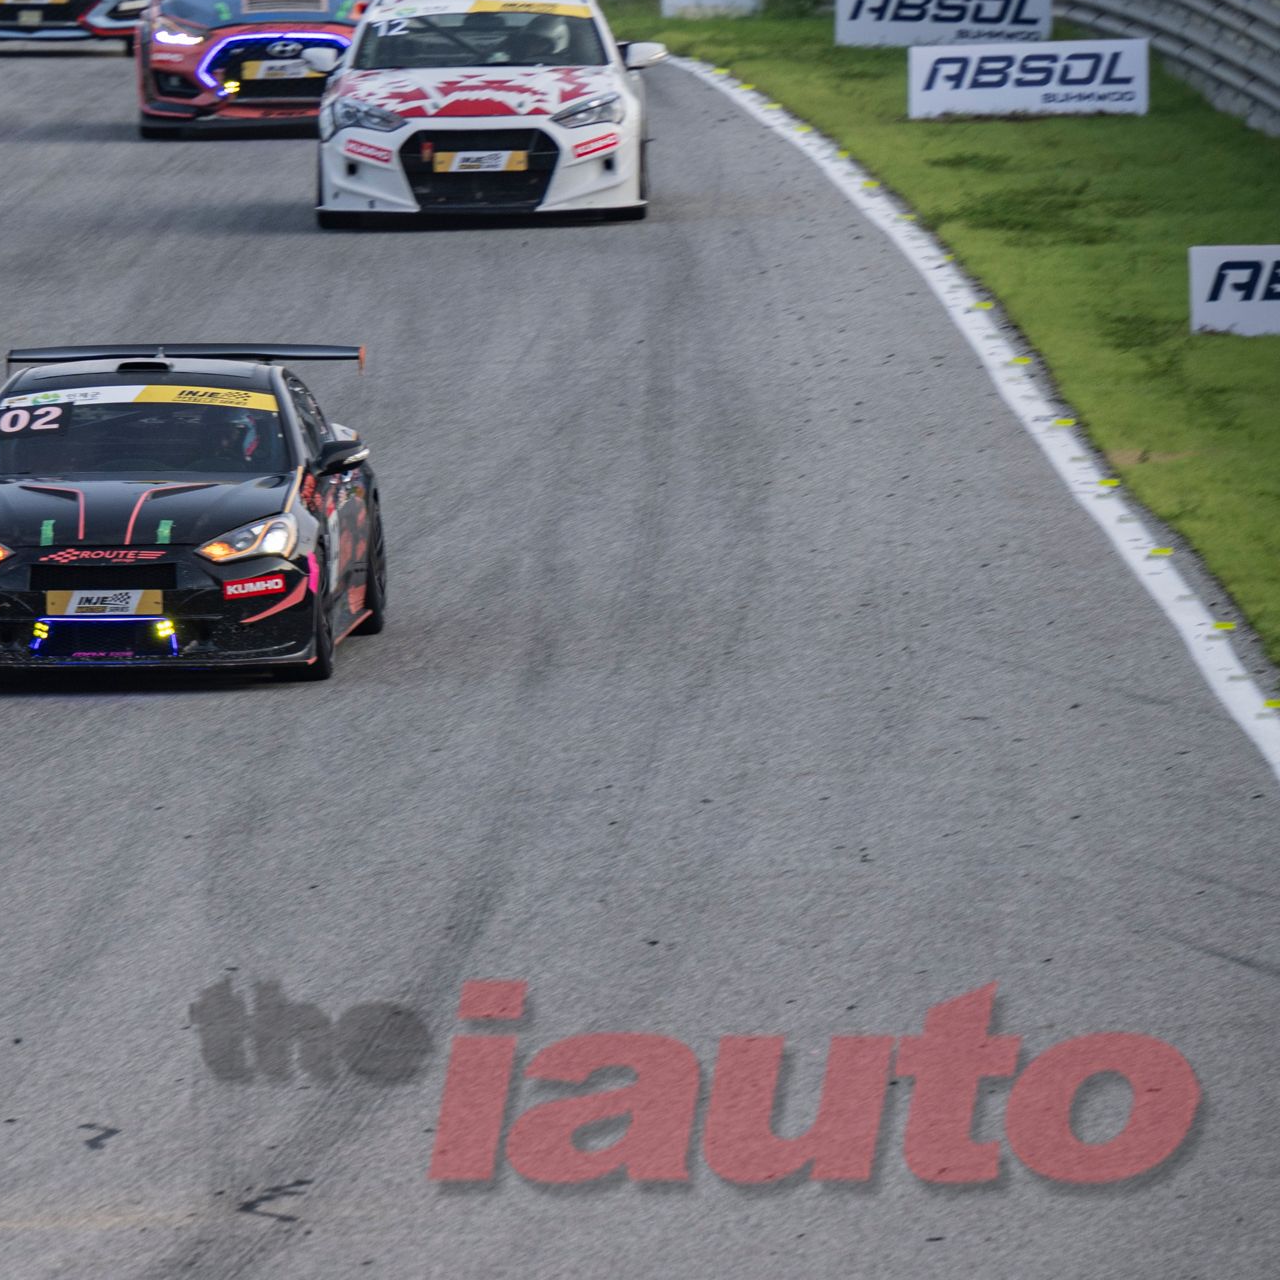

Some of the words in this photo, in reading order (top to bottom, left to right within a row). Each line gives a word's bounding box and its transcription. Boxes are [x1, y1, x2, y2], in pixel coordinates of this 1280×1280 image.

[372, 19, 409, 37] 12
[922, 52, 1137, 91] ABSOL
[79, 550, 139, 559] ROUTE
[226, 578, 284, 596] KUMHO
[77, 596, 109, 605] INJE
